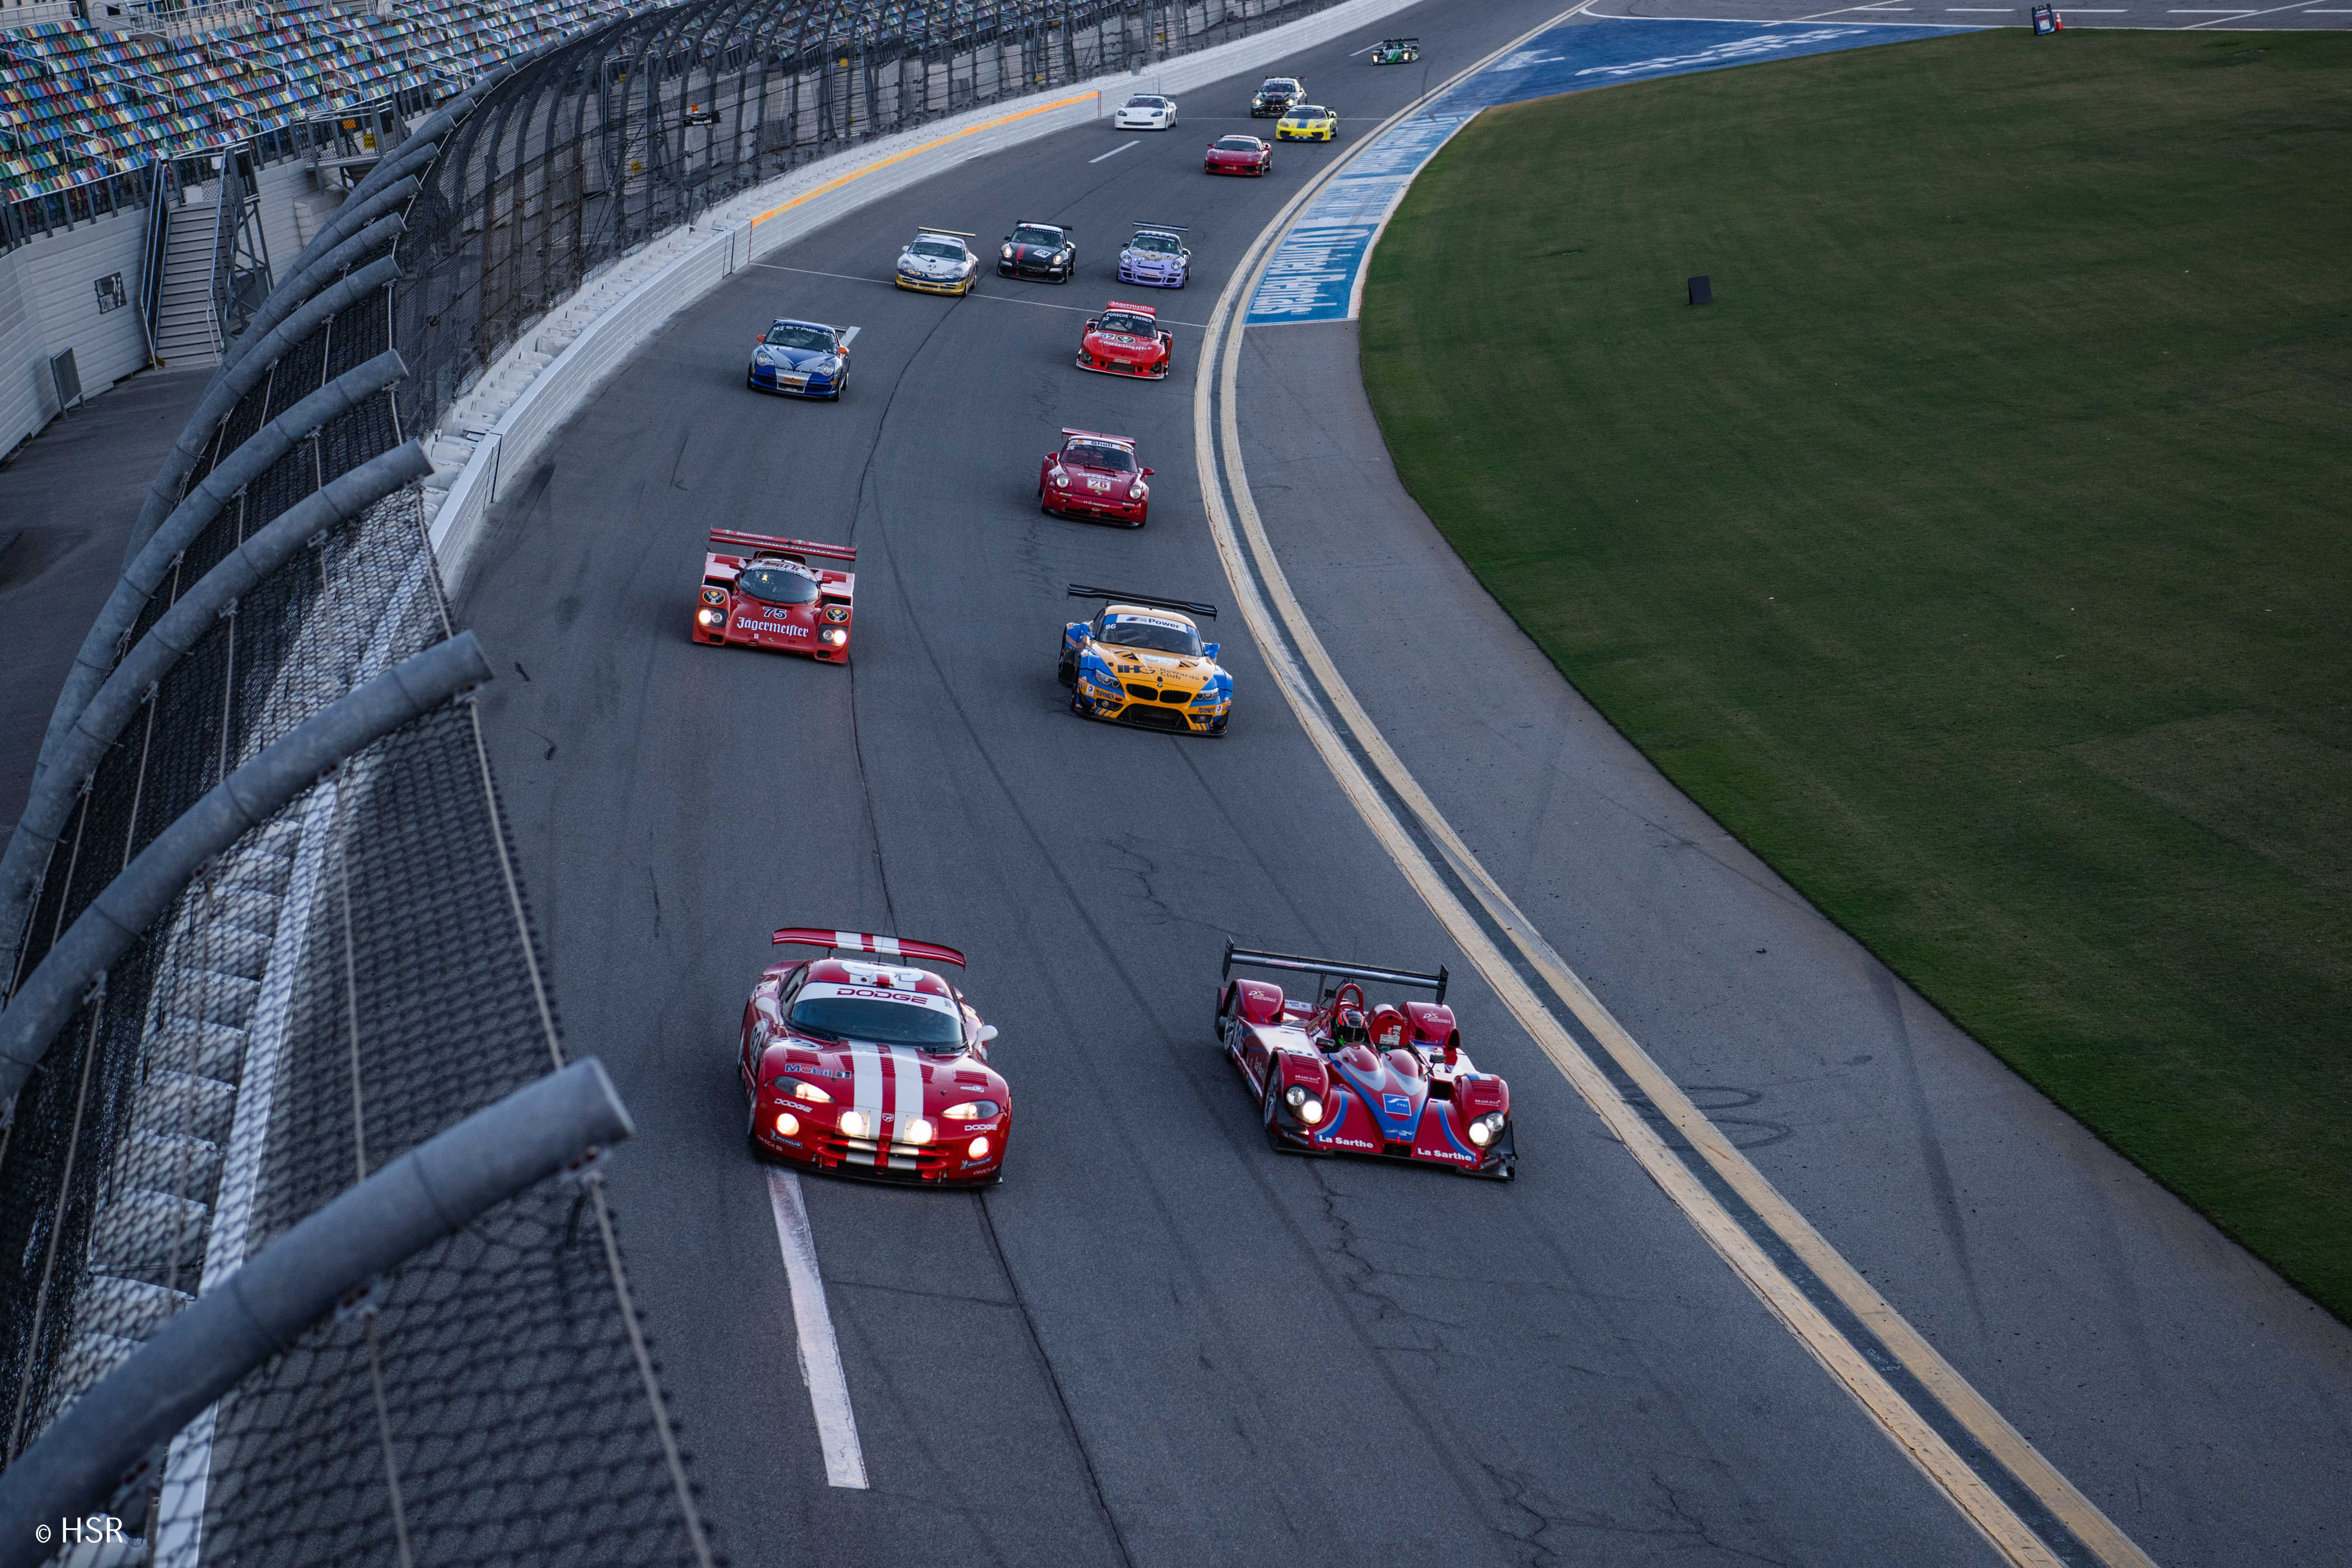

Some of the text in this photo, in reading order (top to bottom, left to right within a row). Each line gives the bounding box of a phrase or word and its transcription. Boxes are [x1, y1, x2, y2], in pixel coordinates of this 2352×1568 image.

[1249, 241, 1357, 315] United Rentals
[786, 326, 831, 337] STABLE
[763, 606, 787, 619] 75
[1149, 618, 1180, 629] Power
[1118, 665, 1155, 674] IHG
[1160, 668, 1200, 680] Rewards
[837, 988, 928, 1005] DODGE
[785, 1065, 832, 1077] Mobil
[774, 1098, 812, 1113] DODGE
[776, 1136, 801, 1147] MICHELIN
[1319, 1135, 1374, 1148] La Sarthe
[1417, 1147, 1472, 1161] La Sarthe
